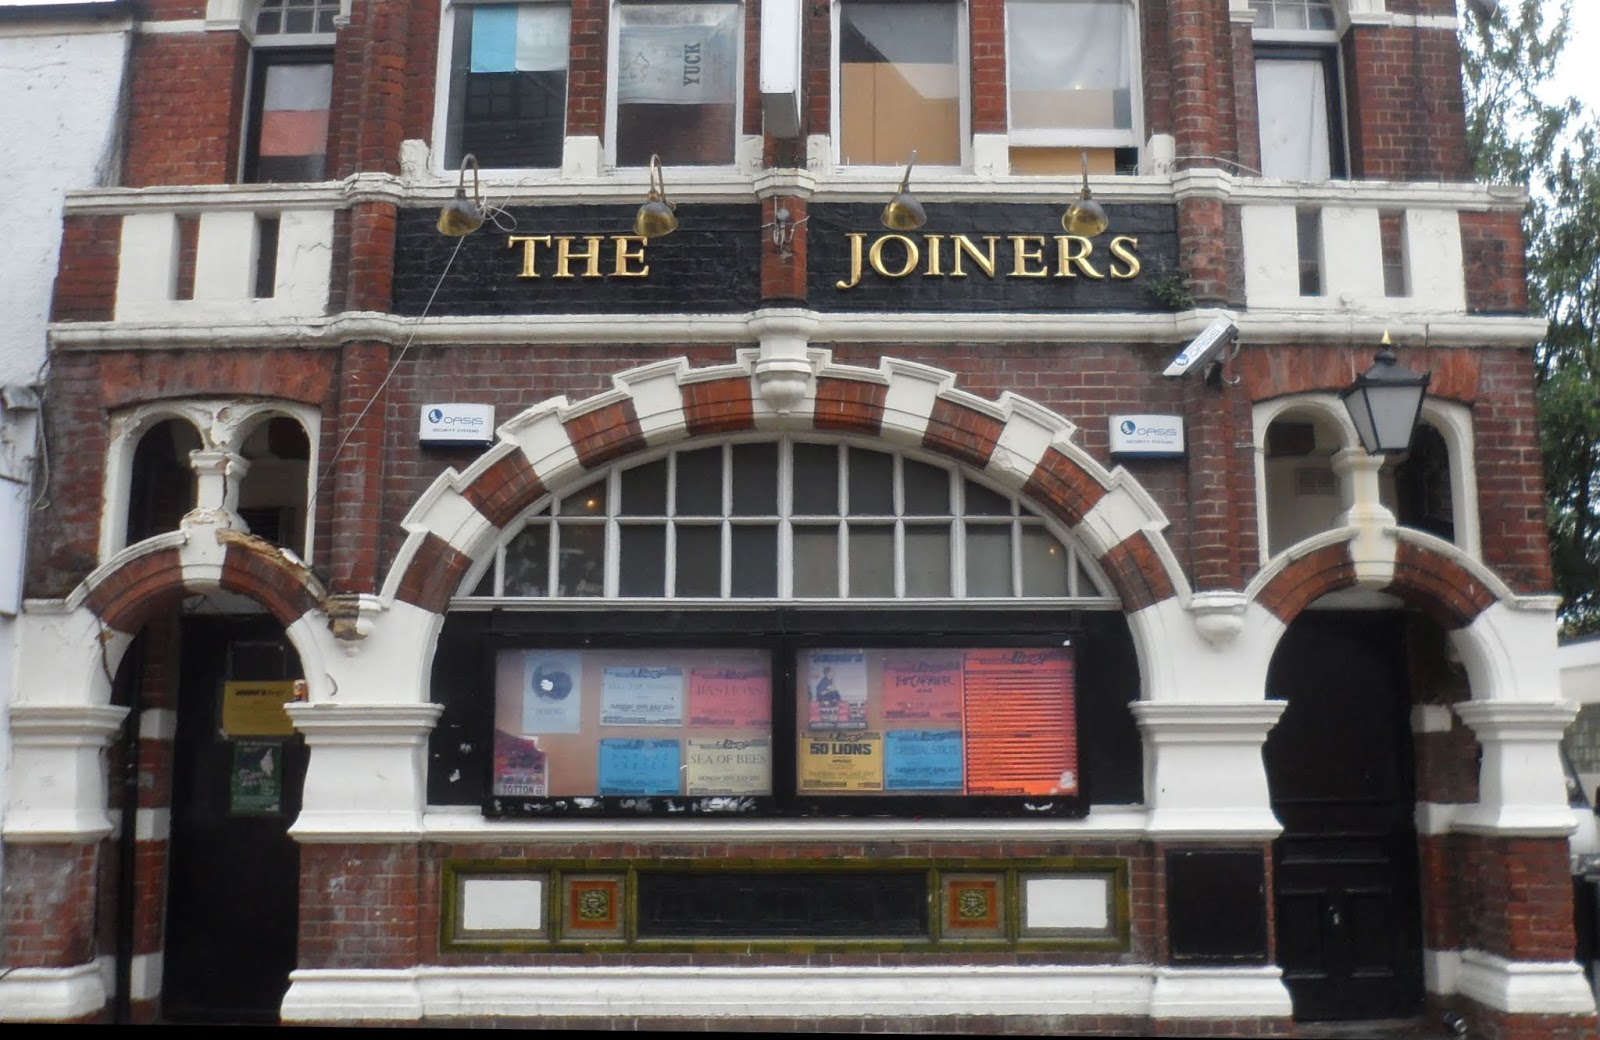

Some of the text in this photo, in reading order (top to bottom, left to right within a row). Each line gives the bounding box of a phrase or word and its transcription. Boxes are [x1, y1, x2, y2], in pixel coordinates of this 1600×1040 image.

[683, 42, 701, 88] YUCK
[507, 232, 1142, 291] THE JOINERS
[443, 416, 484, 426] OASIS
[1136, 427, 1177, 437] OASIS
[809, 743, 872, 755] 50 LIONS
[690, 754, 767, 765] SEA OF BEES
[503, 785, 534, 794] TOTTON
